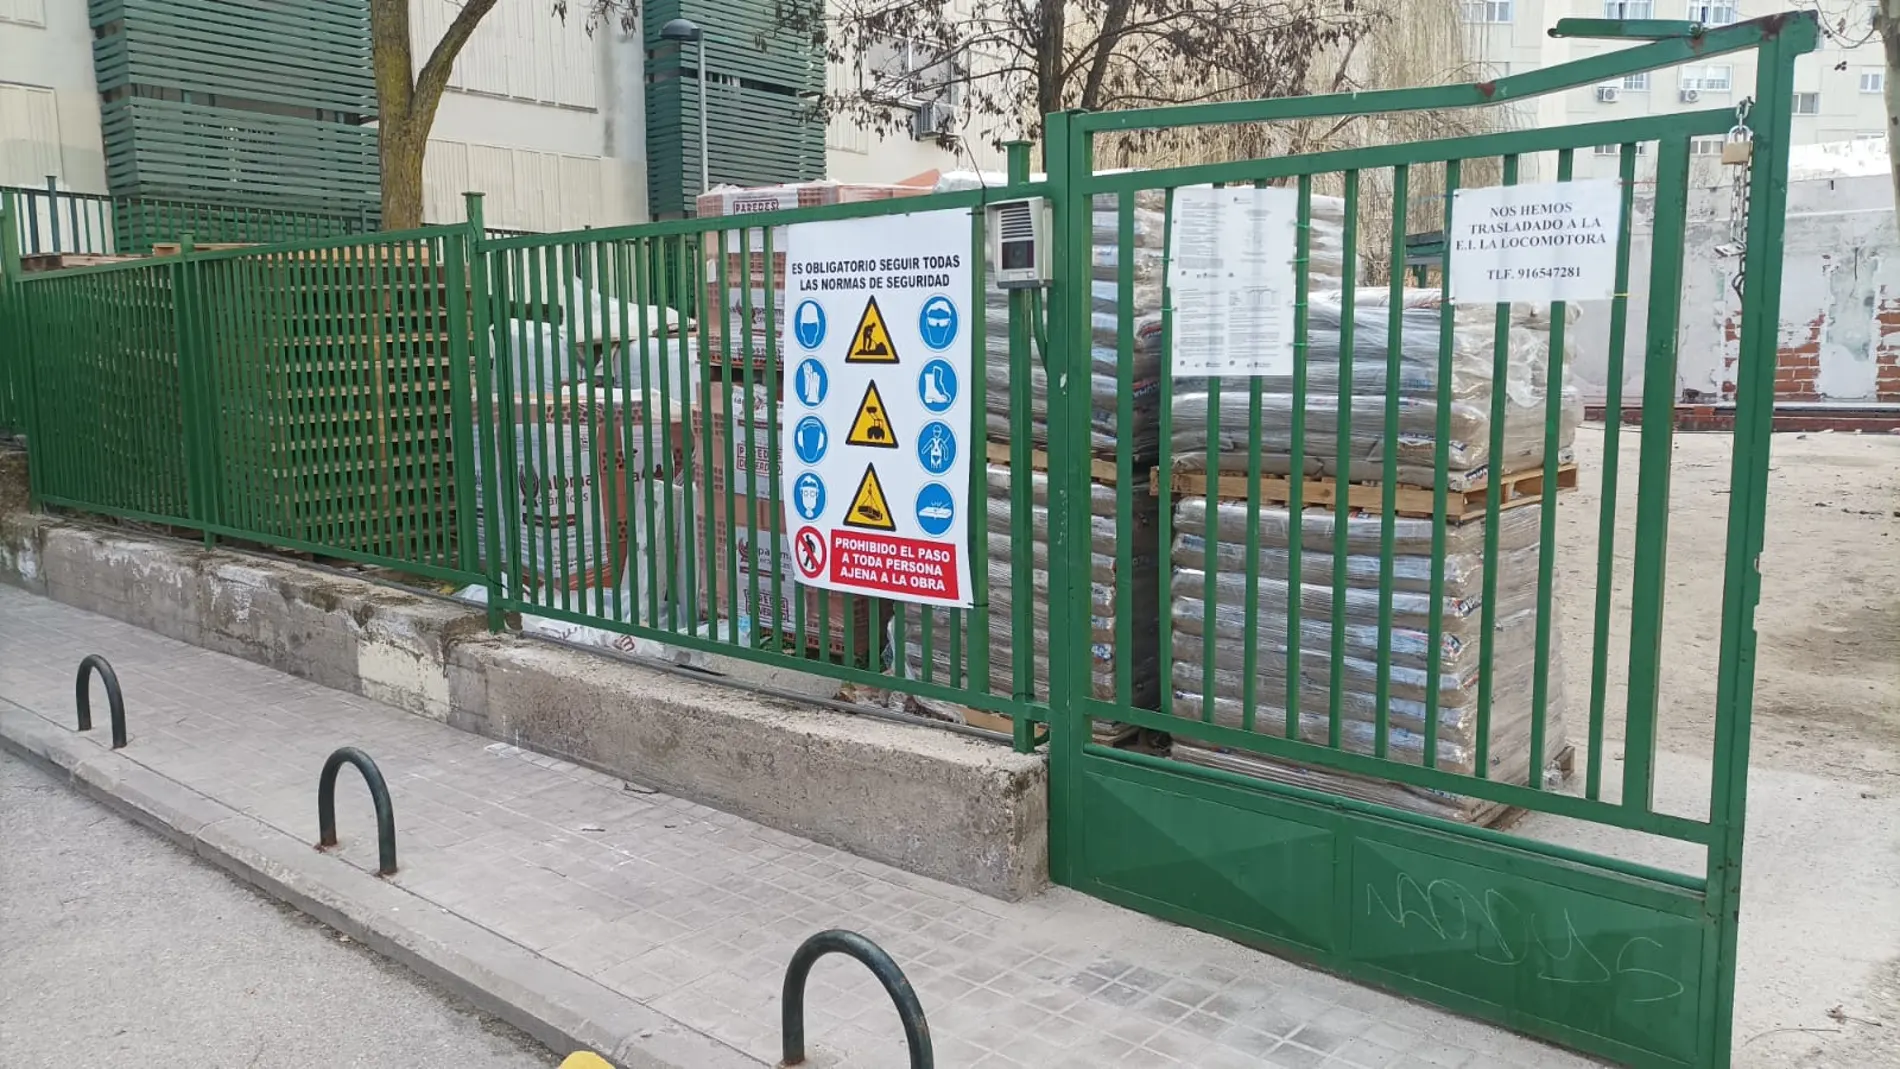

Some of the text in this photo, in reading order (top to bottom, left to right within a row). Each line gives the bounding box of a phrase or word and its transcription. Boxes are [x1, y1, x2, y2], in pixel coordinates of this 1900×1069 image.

[735, 202, 777, 212] PAREDES
[1490, 202, 1573, 218] NOS HEMOS
[1470, 217, 1602, 235] TRASLADADO A LA
[1455, 233, 1607, 251] E.I. LA LOCOMOTORA
[791, 255, 960, 275] ES OBLIGATORIO SEGUIR TODAS
[1487, 266, 1581, 280] TLF. 916547281
[800, 273, 950, 292] LAS NORMAS DE SEGURIDAD
[835, 537, 950, 563] PROHIBIDO EL PASO
[841, 552, 943, 577] A TODA PERSONA
[840, 566, 946, 592] AJENA A LA OBRA
